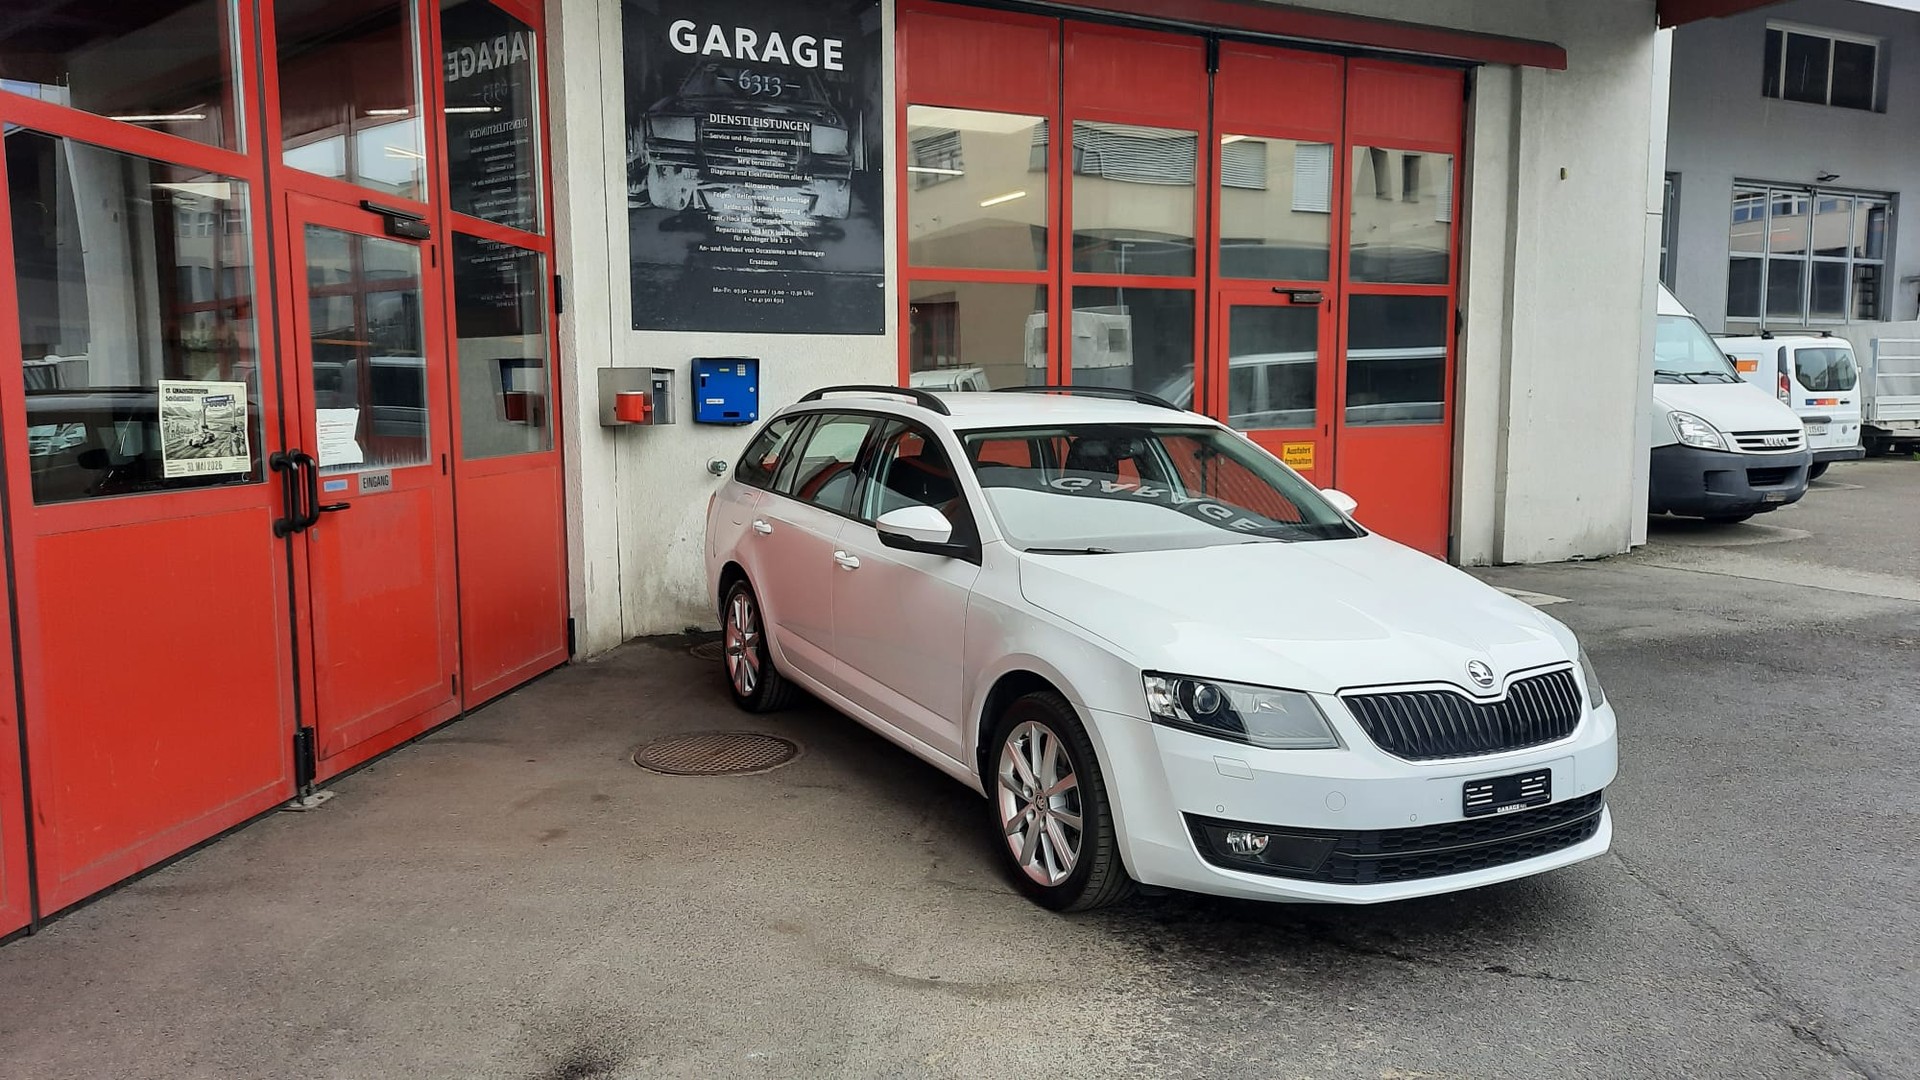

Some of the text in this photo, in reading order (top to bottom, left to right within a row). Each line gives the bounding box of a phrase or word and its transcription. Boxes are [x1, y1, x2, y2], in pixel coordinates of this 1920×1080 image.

[669, 19, 844, 71] GARAGE
[738, 69, 782, 97] 6313
[709, 114, 810, 131] DIENSTLEISTUNGEN
[742, 135, 776, 144] Reparaturen
[791, 139, 811, 147] Marken
[710, 167, 736, 177] Diagnose
[737, 169, 748, 177] und
[791, 173, 803, 181] aller
[803, 173, 814, 183] Art
[744, 181, 779, 190] Klimaservice
[715, 225, 750, 234] Reparaturen
[743, 235, 769, 244] Anhänger
[722, 245, 744, 253] Verkauf
[798, 249, 826, 258] Neuwagen
[749, 258, 779, 266] Ersatzauto
[1764, 435, 1790, 447] IVECO
[362, 474, 389, 489] EINGANG
